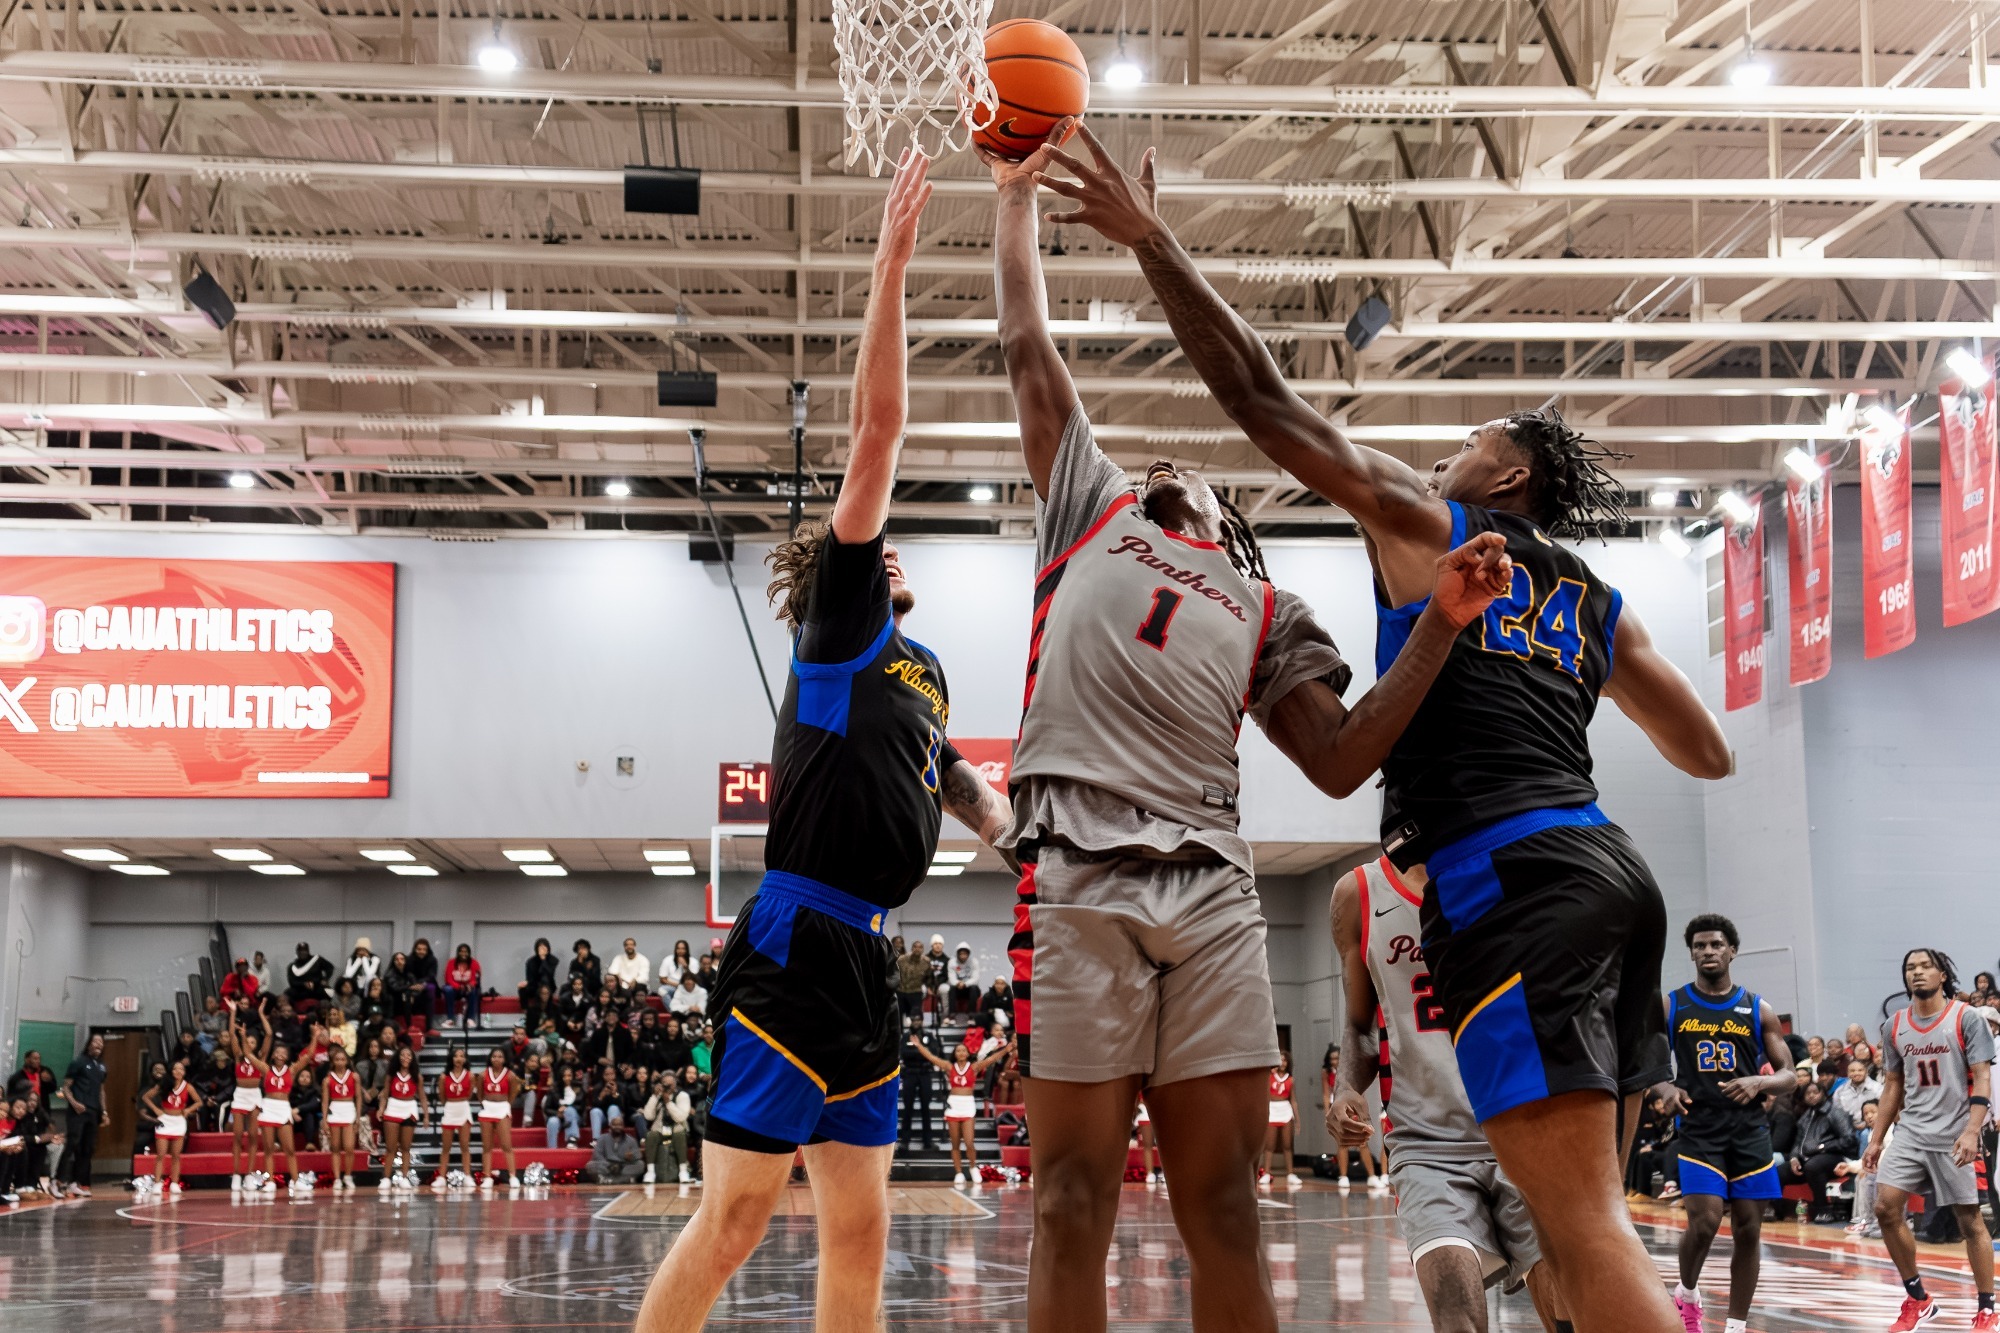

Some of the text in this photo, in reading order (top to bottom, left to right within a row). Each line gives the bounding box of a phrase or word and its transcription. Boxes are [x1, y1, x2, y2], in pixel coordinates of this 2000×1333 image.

[1107, 535, 1247, 622] Panthers
[1960, 541, 1991, 581] 2011
[53, 606, 334, 654] @CAUATHLETICS
[1135, 585, 1184, 652] 1
[1482, 562, 1588, 684] 24
[50, 683, 332, 731] @CAUATHLETICS
[885, 660, 942, 714] Albany
[726, 771, 766, 803] 24
[1410, 972, 1450, 1032] 2
[1678, 1018, 1751, 1036] Albany State
[1903, 1042, 1951, 1057] Panthers
[1696, 1040, 1737, 1072] 23
[1917, 1059, 1941, 1086] 11
